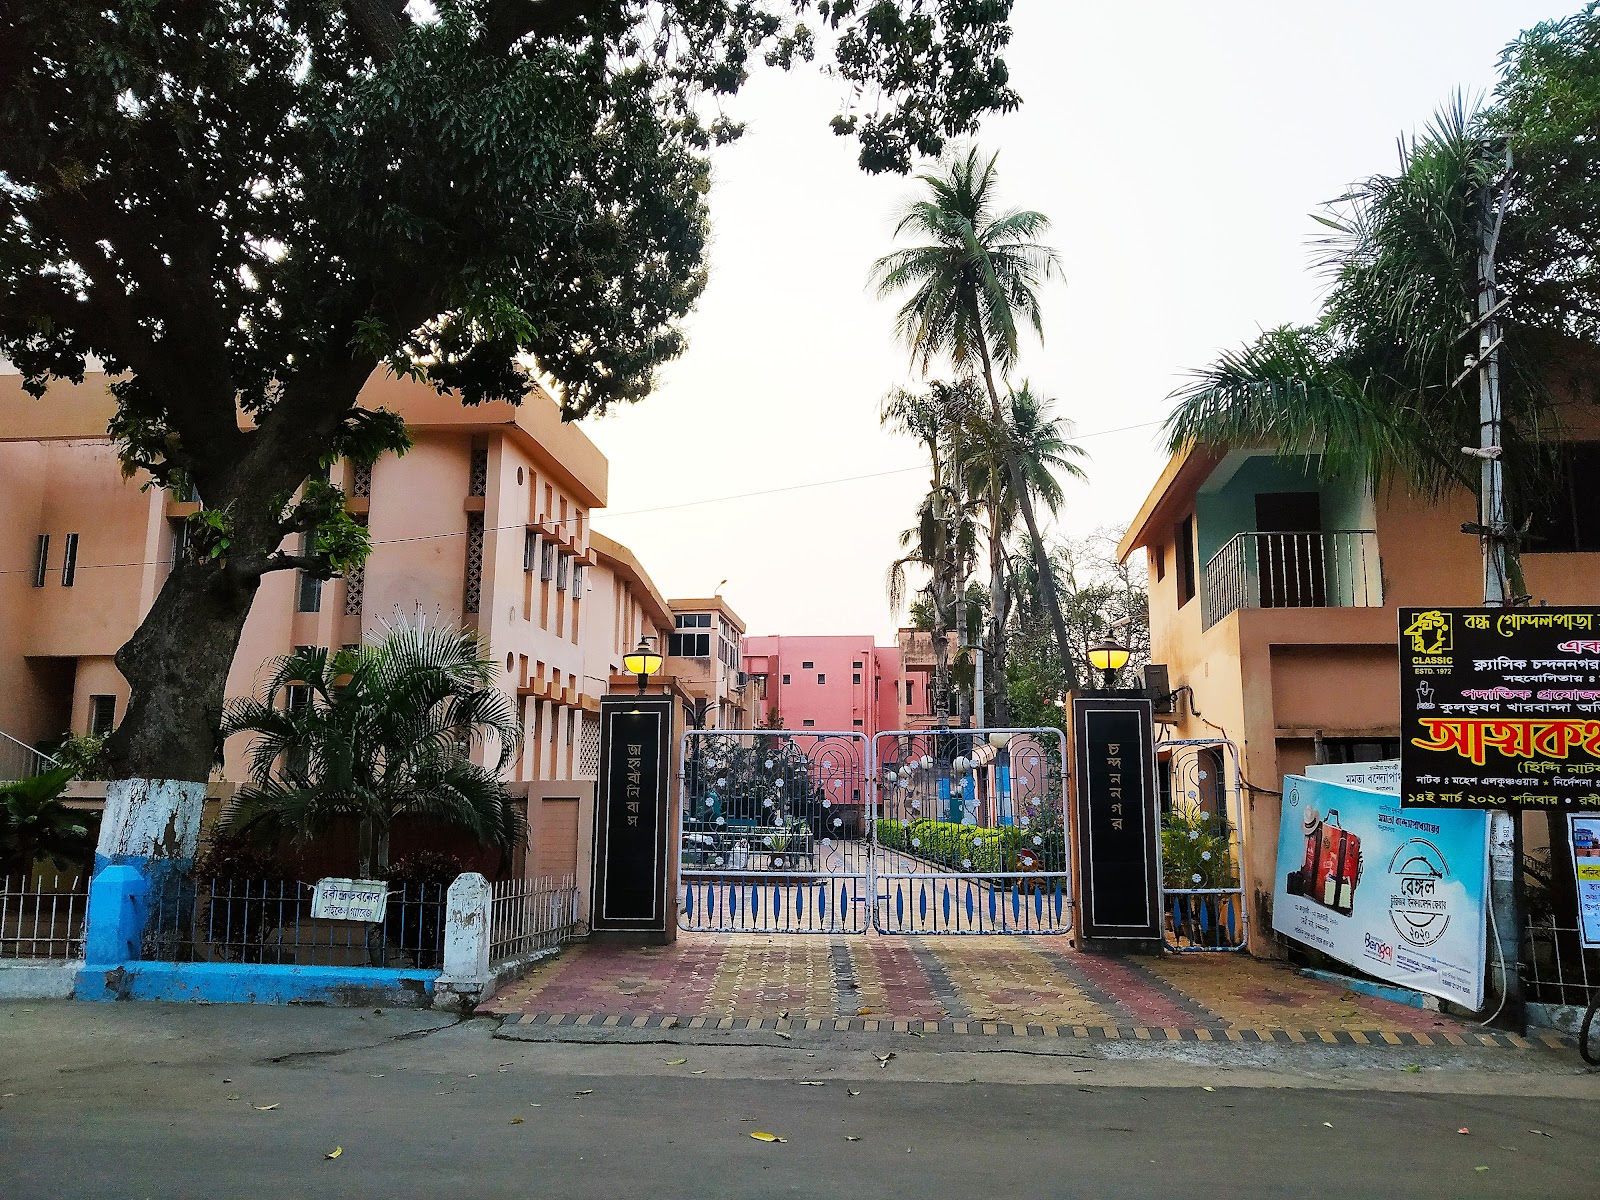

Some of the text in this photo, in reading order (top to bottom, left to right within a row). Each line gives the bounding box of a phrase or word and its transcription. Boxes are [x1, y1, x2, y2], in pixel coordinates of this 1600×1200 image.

[1463, 613, 1594, 637] বন্ধ গোন্দলপাড়া
[1412, 656, 1453, 665] CLASSIC
[1530, 658, 1600, 671] চন্দননগর
[1502, 673, 1584, 684] সহযোগিতায়
[1461, 686, 1532, 701] পদাতিক
[1438, 703, 1501, 715] কুলভূষণ
[1506, 703, 1573, 713] খারবান্দা
[1346, 774, 1365, 784] মমতা
[1416, 774, 1441, 785] নাটক
[1452, 776, 1479, 786] মহেশ
[1552, 776, 1593, 788] নির্দেশনা
[1408, 790, 1436, 803] ১৪ই
[1439, 790, 1463, 803] মার্চ
[1467, 794, 1507, 803] ২০২০
[1511, 792, 1558, 805] শনিবার
[1401, 878, 1436, 897] বেঙ্গল
[1409, 926, 1430, 942] ২০২০
[1364, 932, 1393, 960] Bengal
